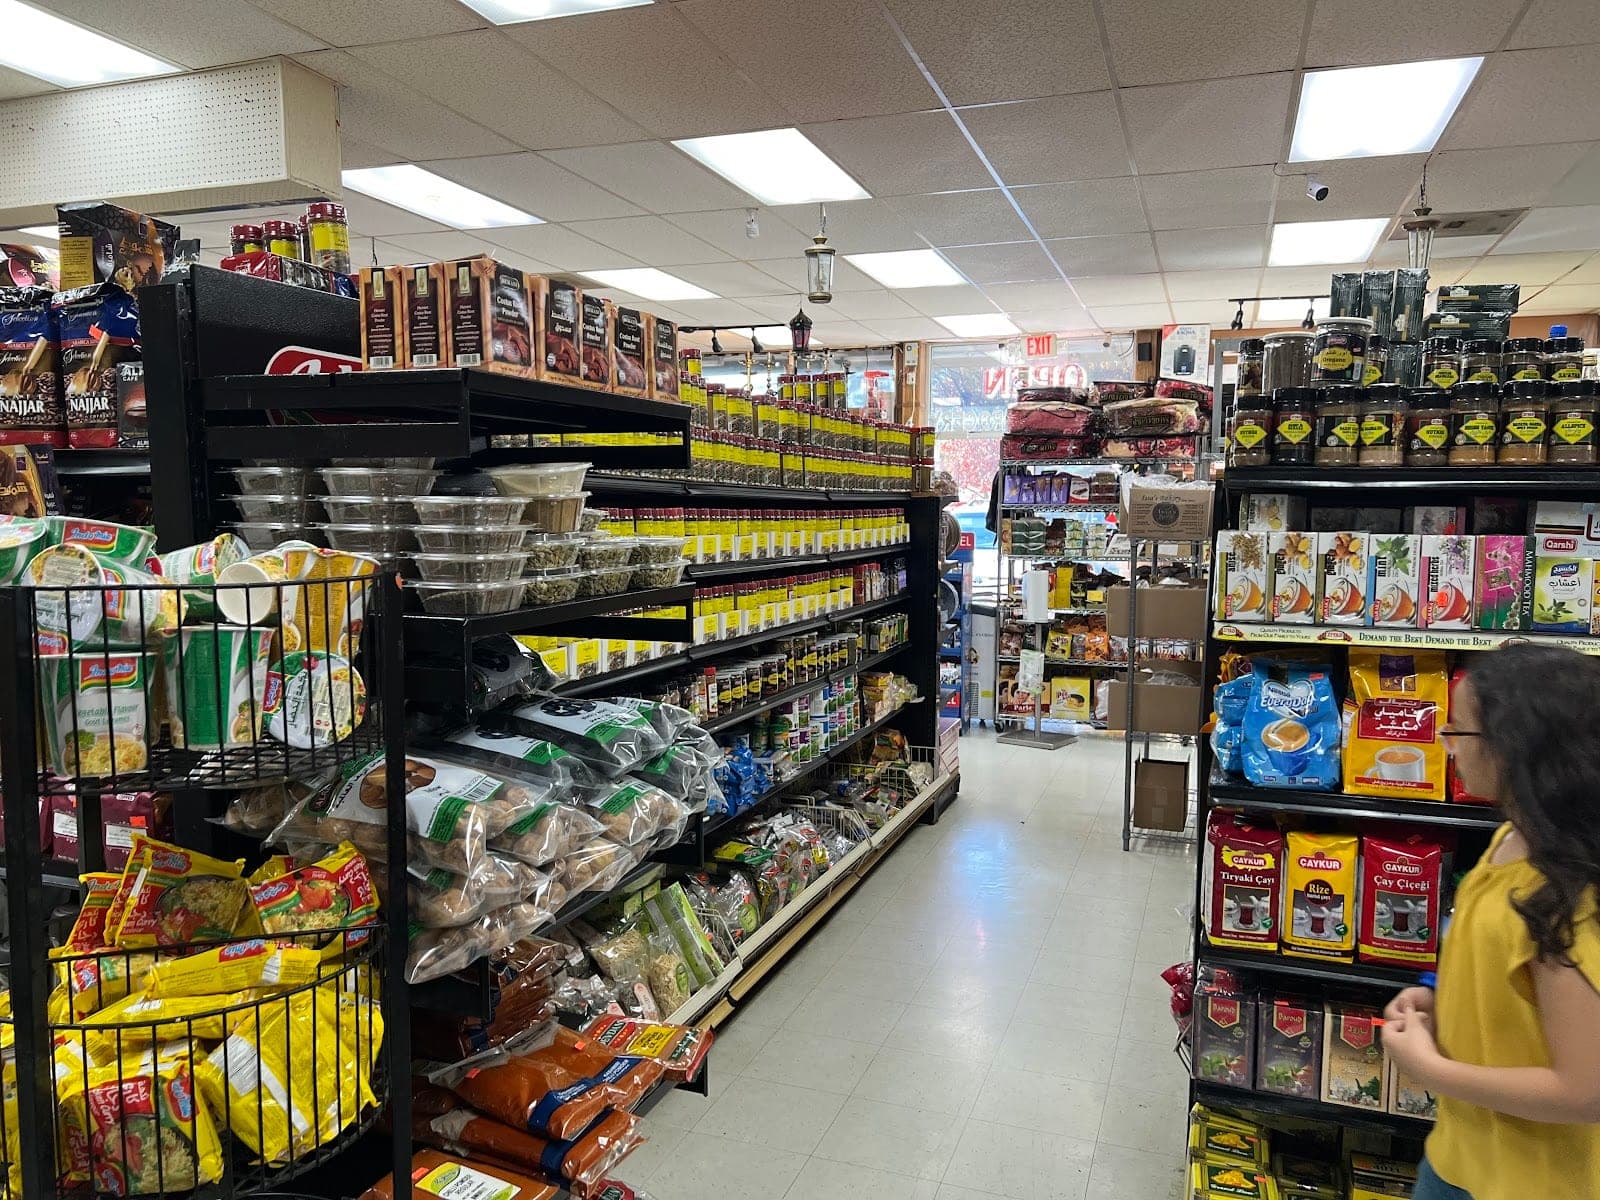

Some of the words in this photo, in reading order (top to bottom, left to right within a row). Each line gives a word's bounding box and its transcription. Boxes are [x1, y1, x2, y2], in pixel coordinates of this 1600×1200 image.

[1027, 336, 1052, 356] EXIT
[0, 400, 45, 416] NAJJAR
[69, 398, 110, 414] NAJJAR
[1546, 540, 1574, 550] Qarshi
[1523, 550, 1534, 599] MAHMOOD
[1522, 600, 1532, 616] TEA
[1359, 633, 1387, 642] DEMAND
[1404, 635, 1422, 643] BEST
[1425, 635, 1454, 645] DEMAND
[1457, 637, 1470, 646] THE
[1472, 637, 1491, 646] BEST
[1220, 872, 1252, 882] Tiryaki
[1255, 875, 1275, 885] Çayı
[1374, 875, 1394, 888] Çay
[1397, 879, 1430, 891] Çiçeği
[1308, 883, 1330, 893] Rize
